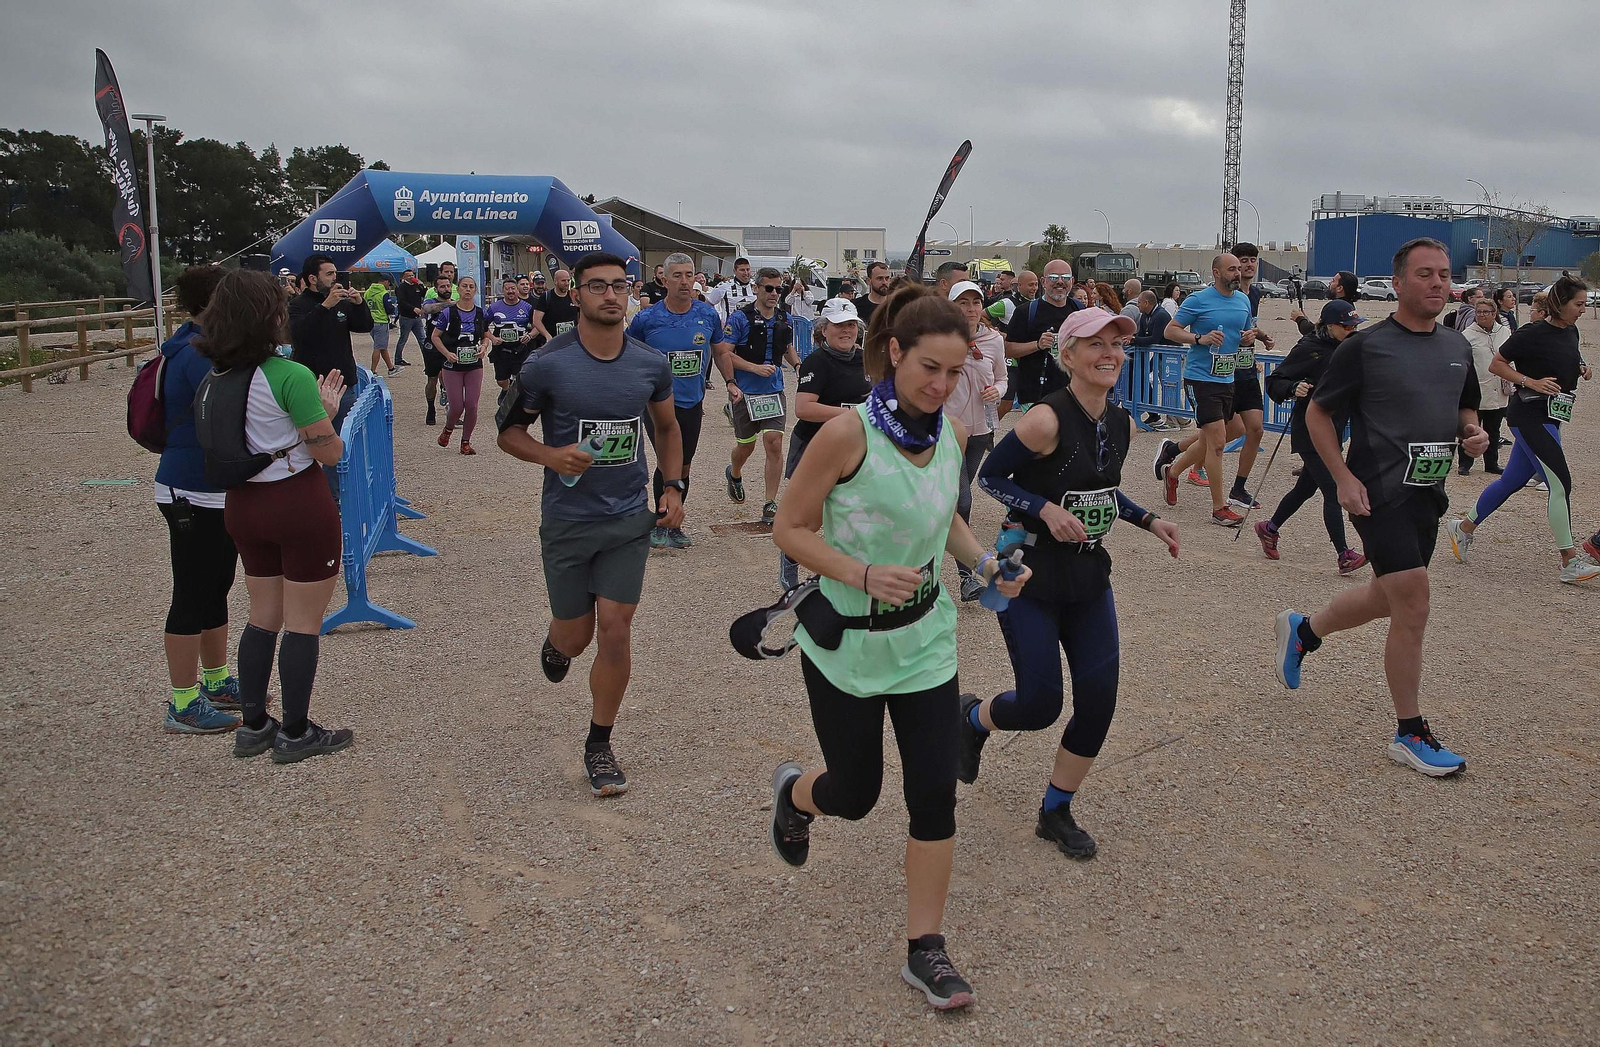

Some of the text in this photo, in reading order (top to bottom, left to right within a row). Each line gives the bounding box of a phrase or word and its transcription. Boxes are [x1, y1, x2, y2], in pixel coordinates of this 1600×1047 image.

[419, 190, 529, 206] Ayuntamiento
[432, 207, 518, 220] de La Línea
[319, 223, 330, 234] D
[566, 225, 577, 236] D
[313, 244, 356, 252] DEPORTES
[563, 244, 602, 252] DEPORTES
[674, 360, 698, 370] 237
[800, 375, 811, 384] 2019
[755, 402, 776, 412] 407
[595, 422, 612, 430] XIII
[880, 407, 908, 438] SIERRA
[602, 435, 634, 453] 74
[1423, 445, 1438, 453] XIII
[1417, 459, 1451, 475] 377
[1078, 493, 1096, 502] XIII
